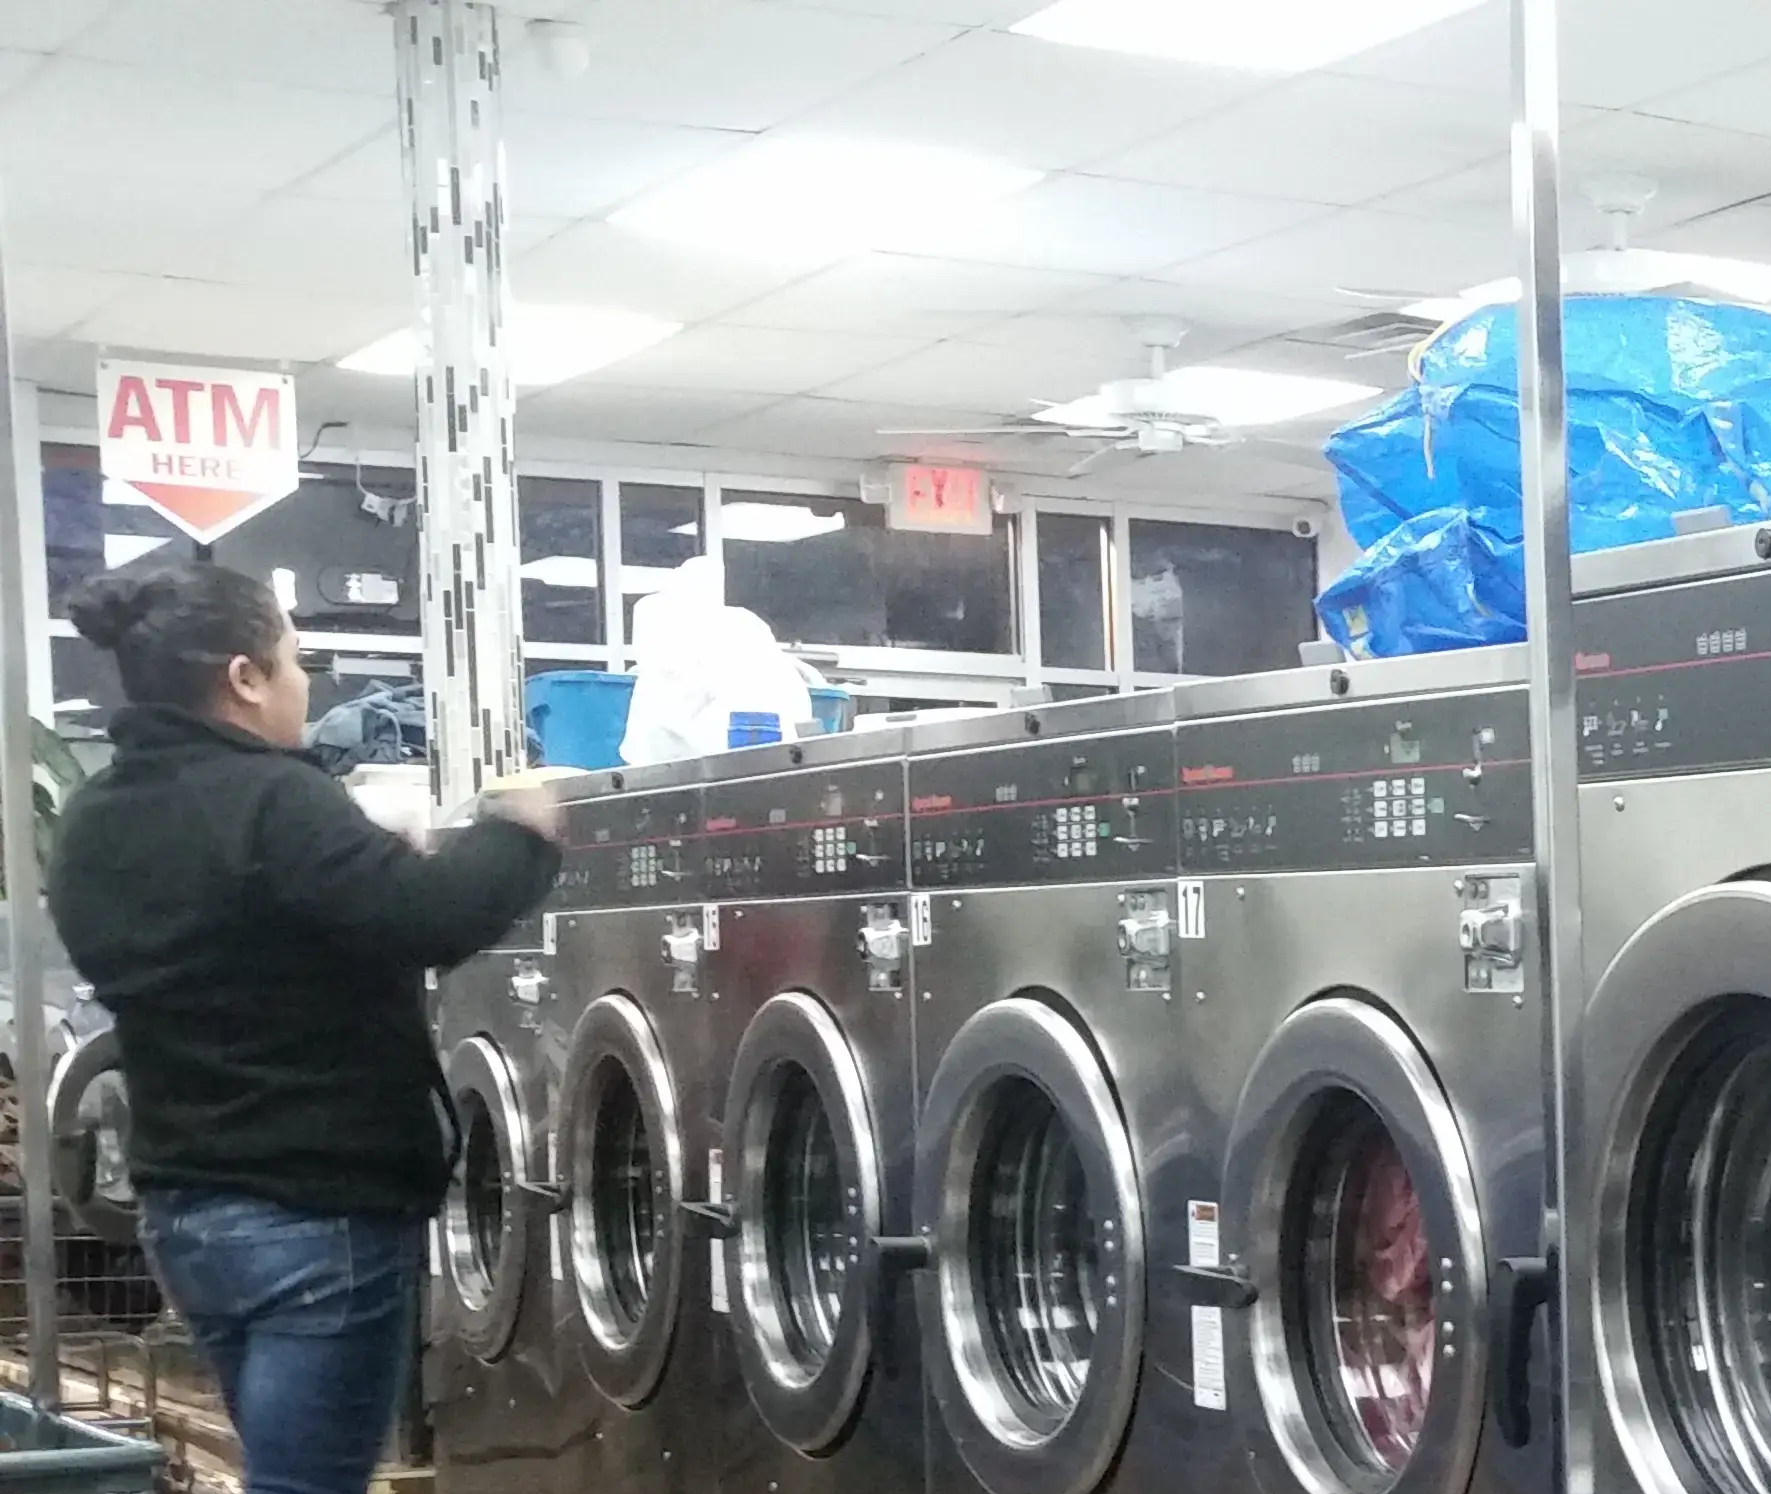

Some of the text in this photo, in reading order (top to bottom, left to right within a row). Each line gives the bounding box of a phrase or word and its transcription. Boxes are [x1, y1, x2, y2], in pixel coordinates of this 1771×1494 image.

[107, 375, 281, 451] ATM
[152, 452, 243, 481] HERE
[1182, 885, 1201, 935] 17
